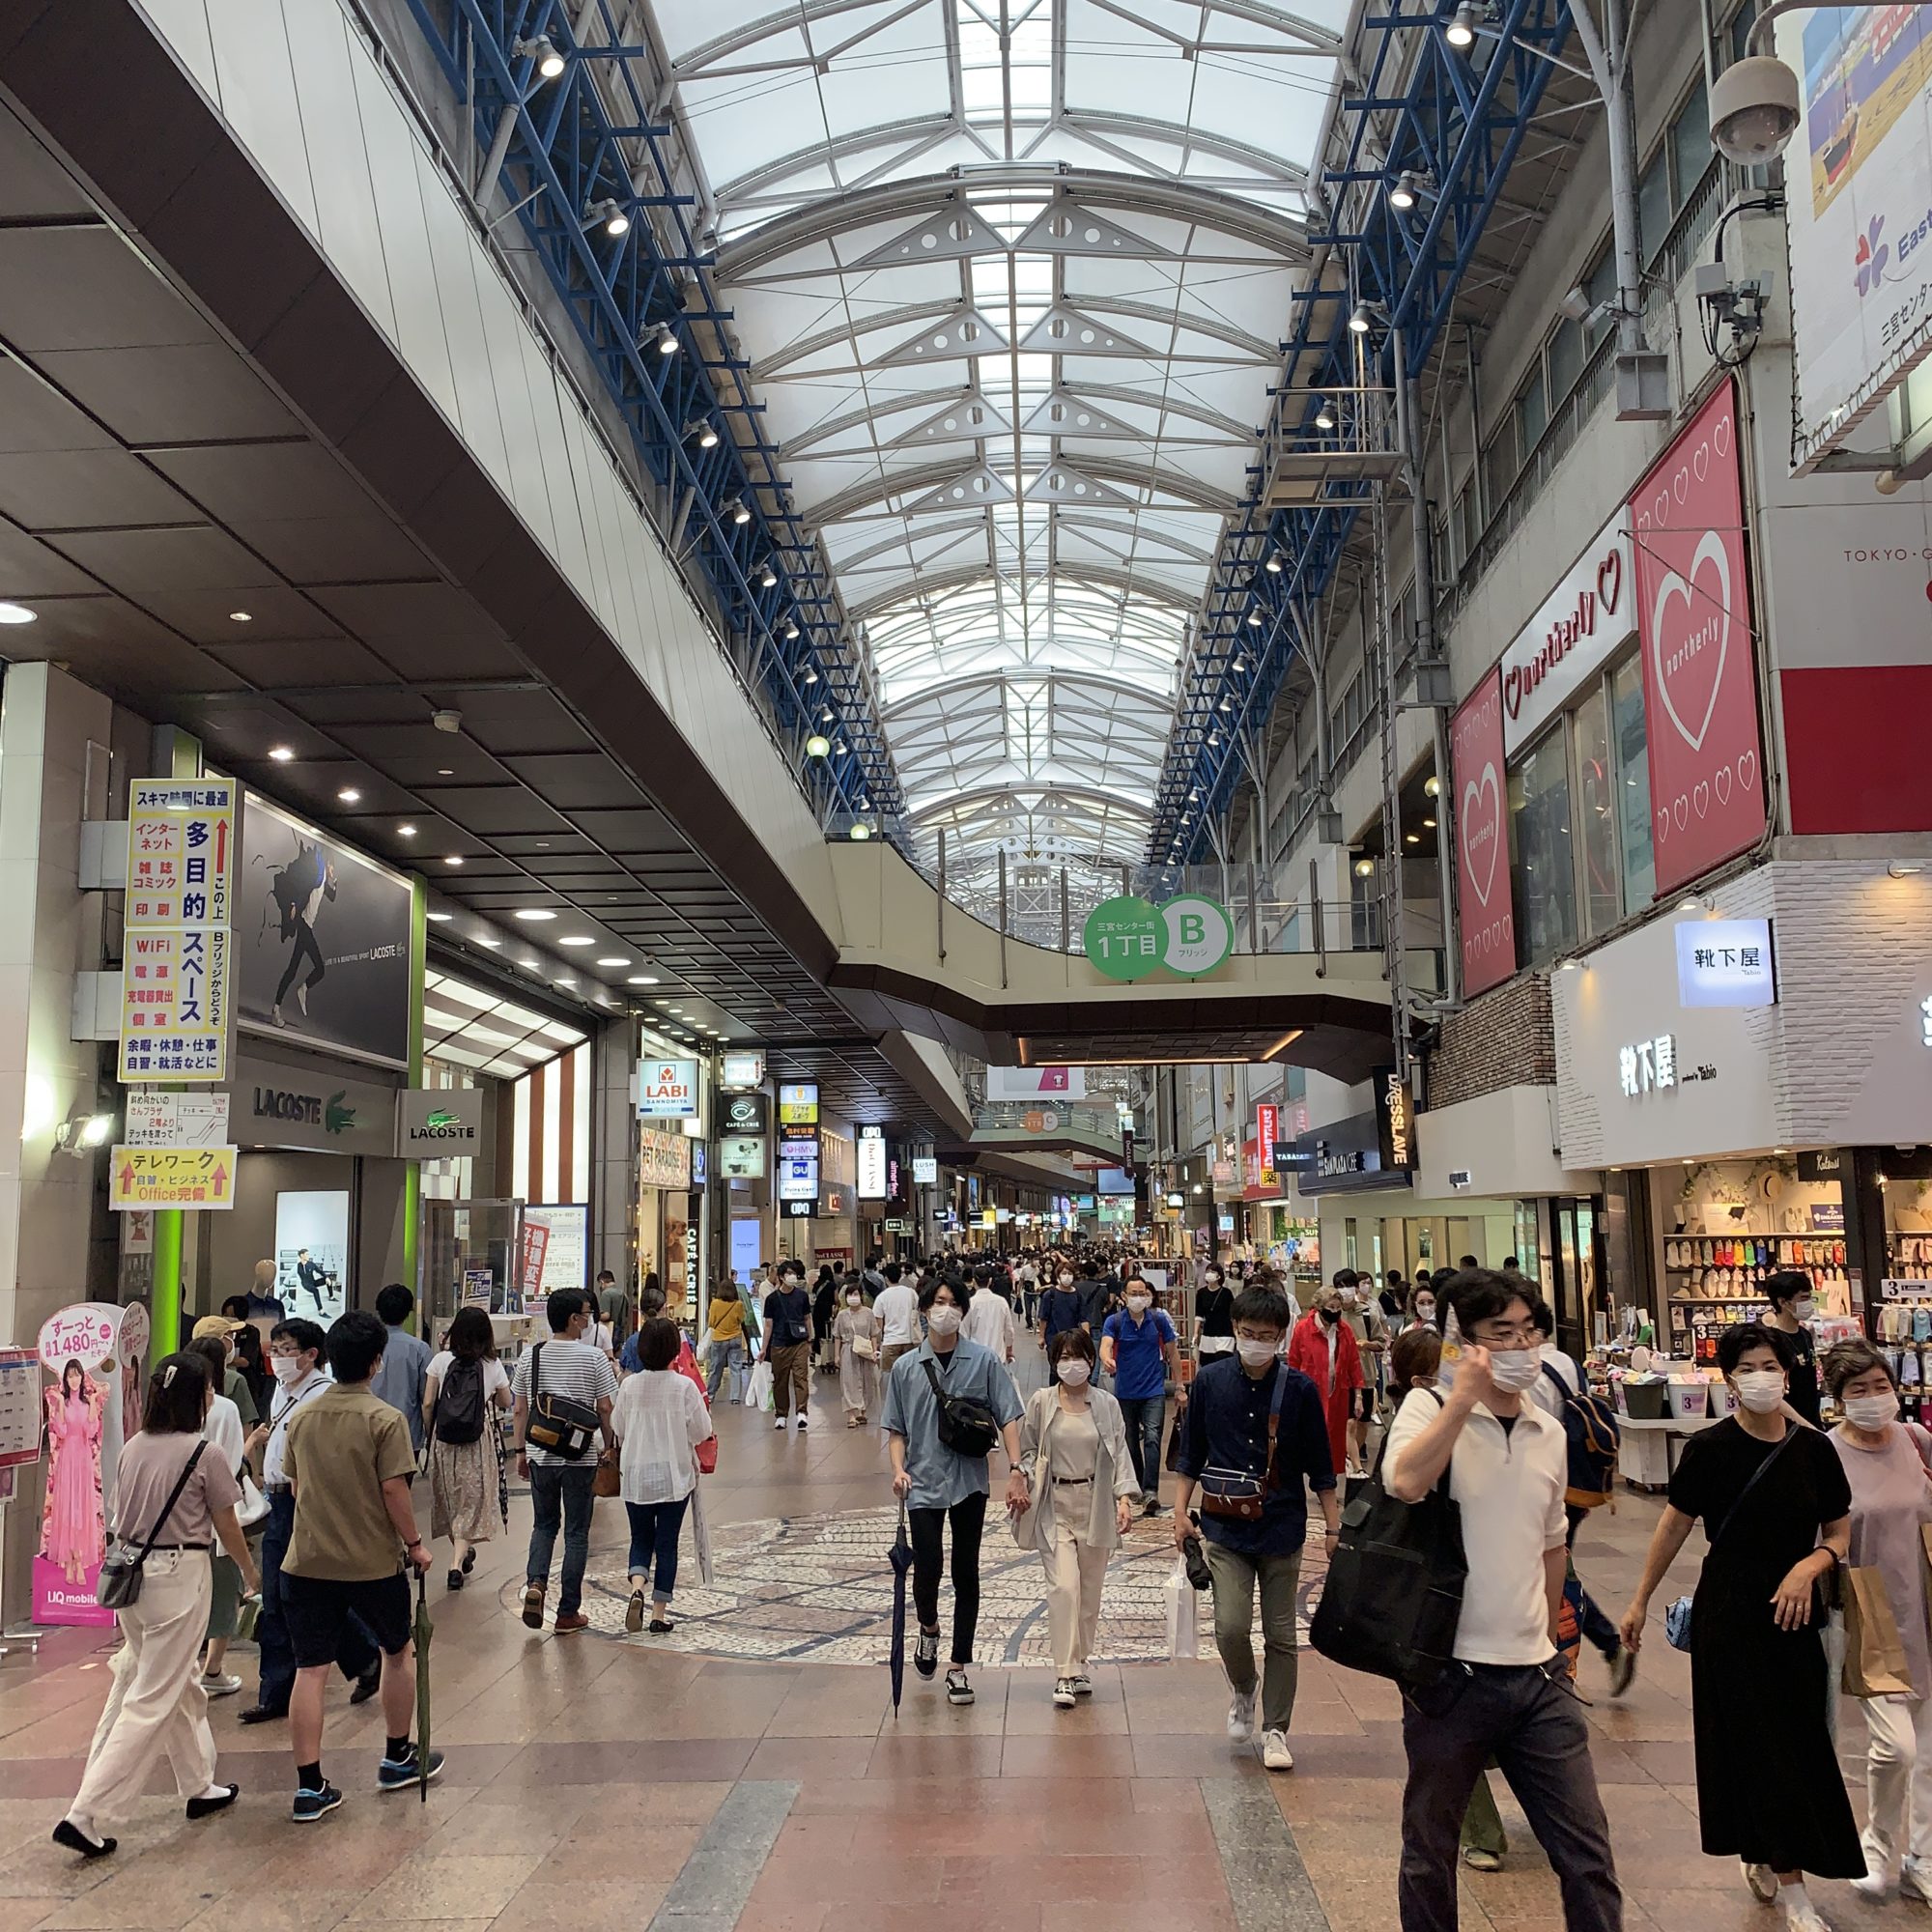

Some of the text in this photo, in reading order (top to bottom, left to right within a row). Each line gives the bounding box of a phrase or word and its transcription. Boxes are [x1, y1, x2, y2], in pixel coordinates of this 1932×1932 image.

[1666, 616, 1719, 677] northerly
[137, 791, 228, 807] スキマ時間に最適
[135, 823, 179, 836] インター
[141, 838, 173, 850] ネット
[183, 821, 209, 920] 多目的
[133, 877, 177, 889] コミック
[213, 877, 224, 920] この上
[1096, 922, 1155, 932] 三宮センター街
[1179, 914, 1206, 945] B
[136, 940, 170, 952] WiFi
[370, 945, 396, 960] LACOSTE
[1098, 934, 1156, 958] 1丁目
[1694, 948, 1760, 968] 靴下屋
[180, 932, 204, 1022] スペース
[128, 1057, 216, 1069] 自習・就活などに
[1620, 1035, 1676, 1097] 靴下屋
[1697, 1064, 1717, 1081] Tabio
[646, 1085, 688, 1097] LABI
[253, 1087, 322, 1124] LACOSTE
[411, 1127, 474, 1139] LACOSTE
[133, 1151, 214, 1170] テレワーク
[793, 1165, 808, 1175] GU
[687, 1228, 697, 1260] CAFÉ
[686, 1274, 697, 1303] CRIÉ
[1889, 1281, 1899, 1295] 3
[51, 1316, 95, 1337] ずーっと
[1696, 1324, 1707, 1339] 3
[1684, 1397, 1691, 1409] 3
[47, 1591, 65, 1605] UQ
